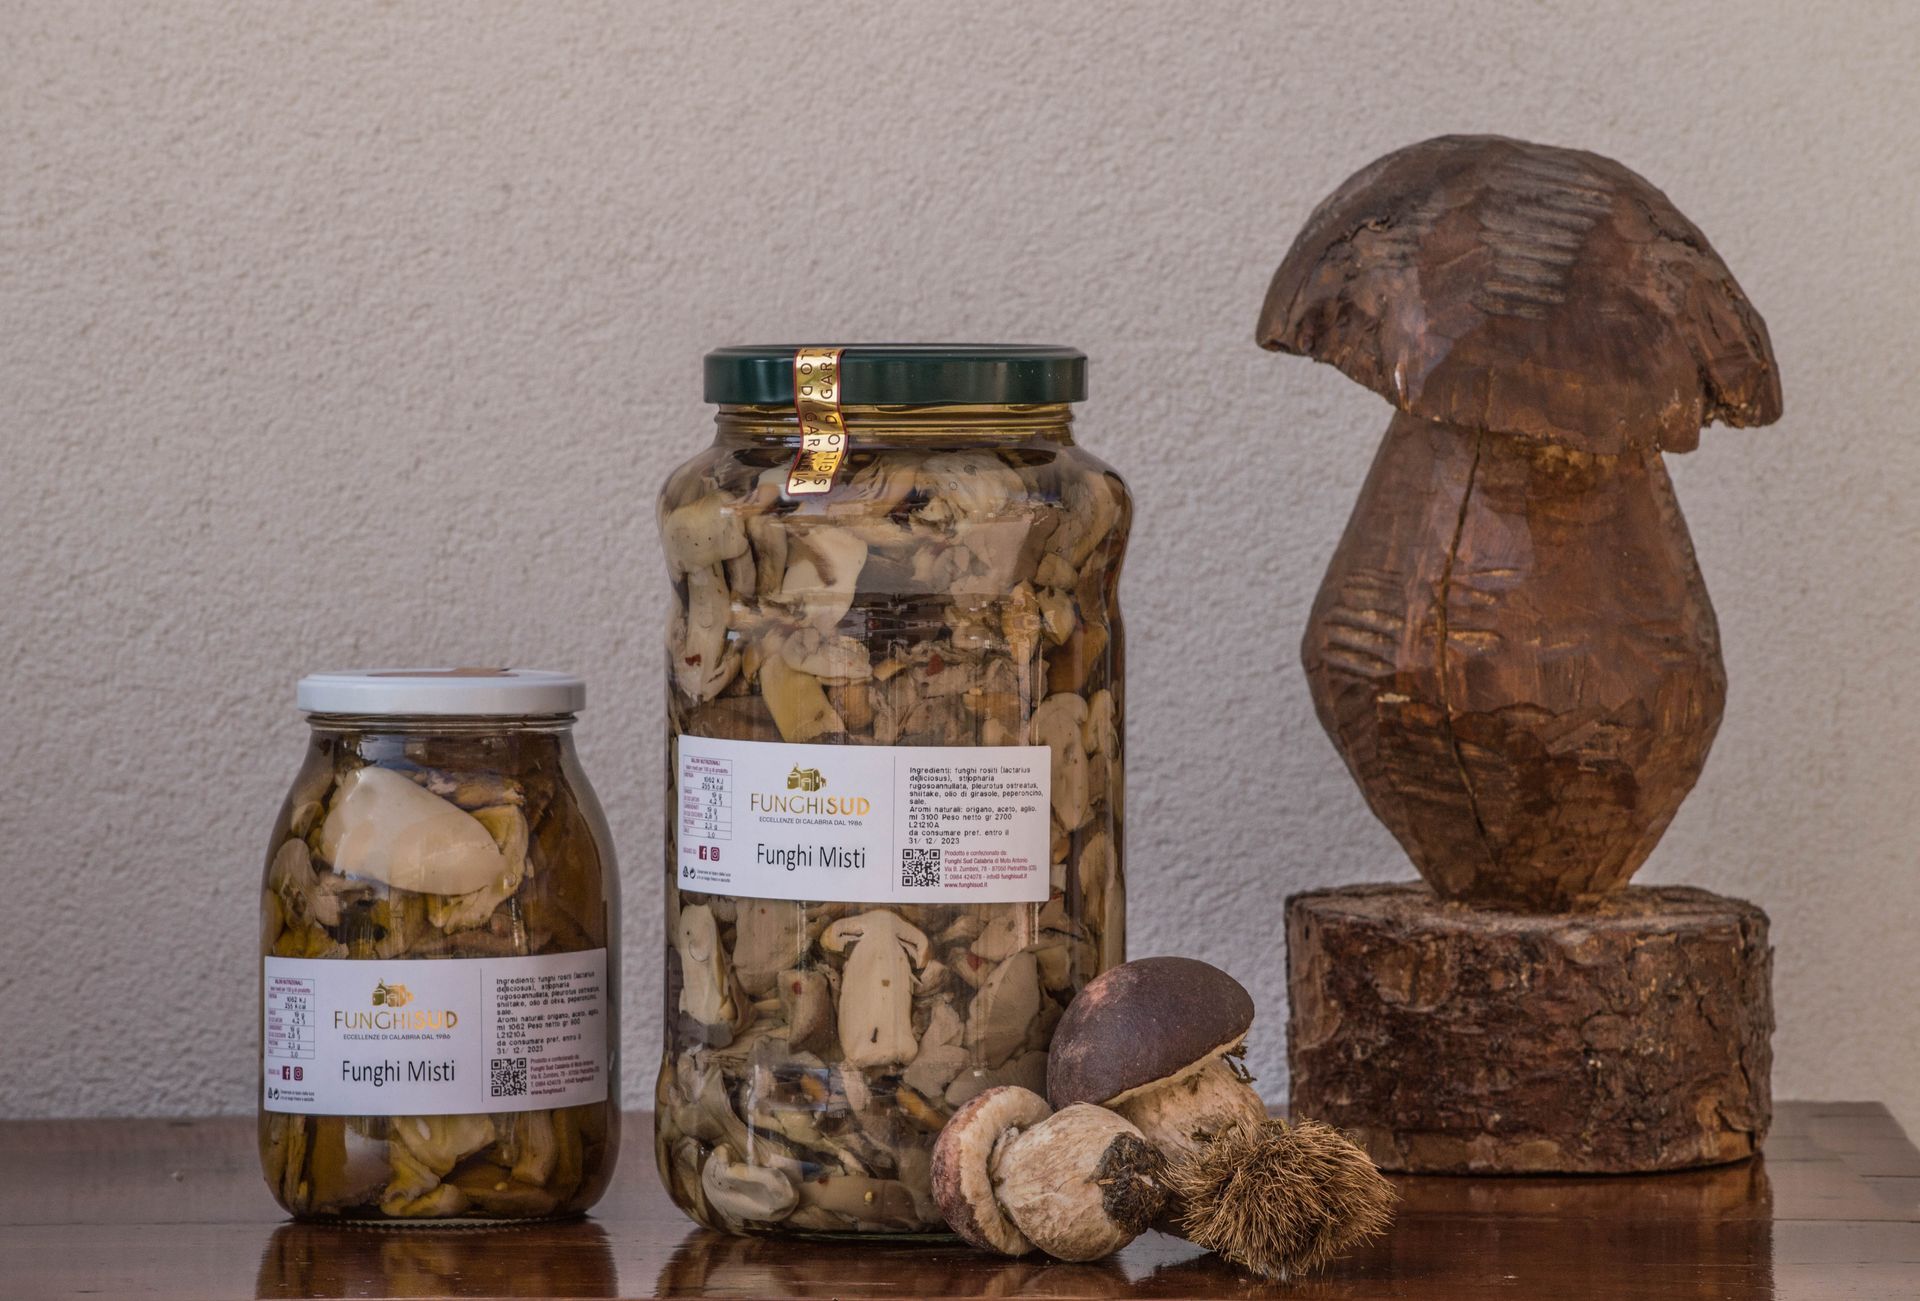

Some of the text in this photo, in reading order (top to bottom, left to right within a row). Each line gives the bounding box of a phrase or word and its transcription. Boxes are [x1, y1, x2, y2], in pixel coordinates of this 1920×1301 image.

[801, 385, 813, 403] DI
[823, 409, 838, 425] DI
[814, 433, 840, 485] SIGILLO
[909, 767, 952, 776] Ingredienti:
[955, 767, 977, 776] funghi
[971, 782, 1004, 791] pleurotus
[970, 790, 1000, 798] girasole,
[1002, 790, 1044, 798] peperoncino,
[751, 793, 871, 816] FUNGHISUD
[965, 806, 995, 814] origano,
[759, 816, 795, 824] ECCELLENZE
[802, 818, 833, 826] CALABRIA
[908, 813, 918, 821] ml
[920, 813, 939, 821] 3100
[941, 813, 960, 821] Peso
[984, 814, 992, 822] gr
[994, 813, 1013, 821] 2700
[908, 821, 940, 829] L21210A
[963, 830, 982, 838] pref.
[941, 837, 960, 845] 2023
[757, 843, 866, 872] Funghi Misti
[944, 858, 962, 866] Funghi
[334, 1010, 459, 1030] FUNGHISUD
[497, 1015, 518, 1024] Aromi
[436, 1032, 451, 1040] 1986
[496, 1039, 507, 1047] da
[508, 1038, 544, 1046] consumare
[527, 1045, 544, 1053] 2023
[342, 1059, 455, 1087] Funghi Misti
